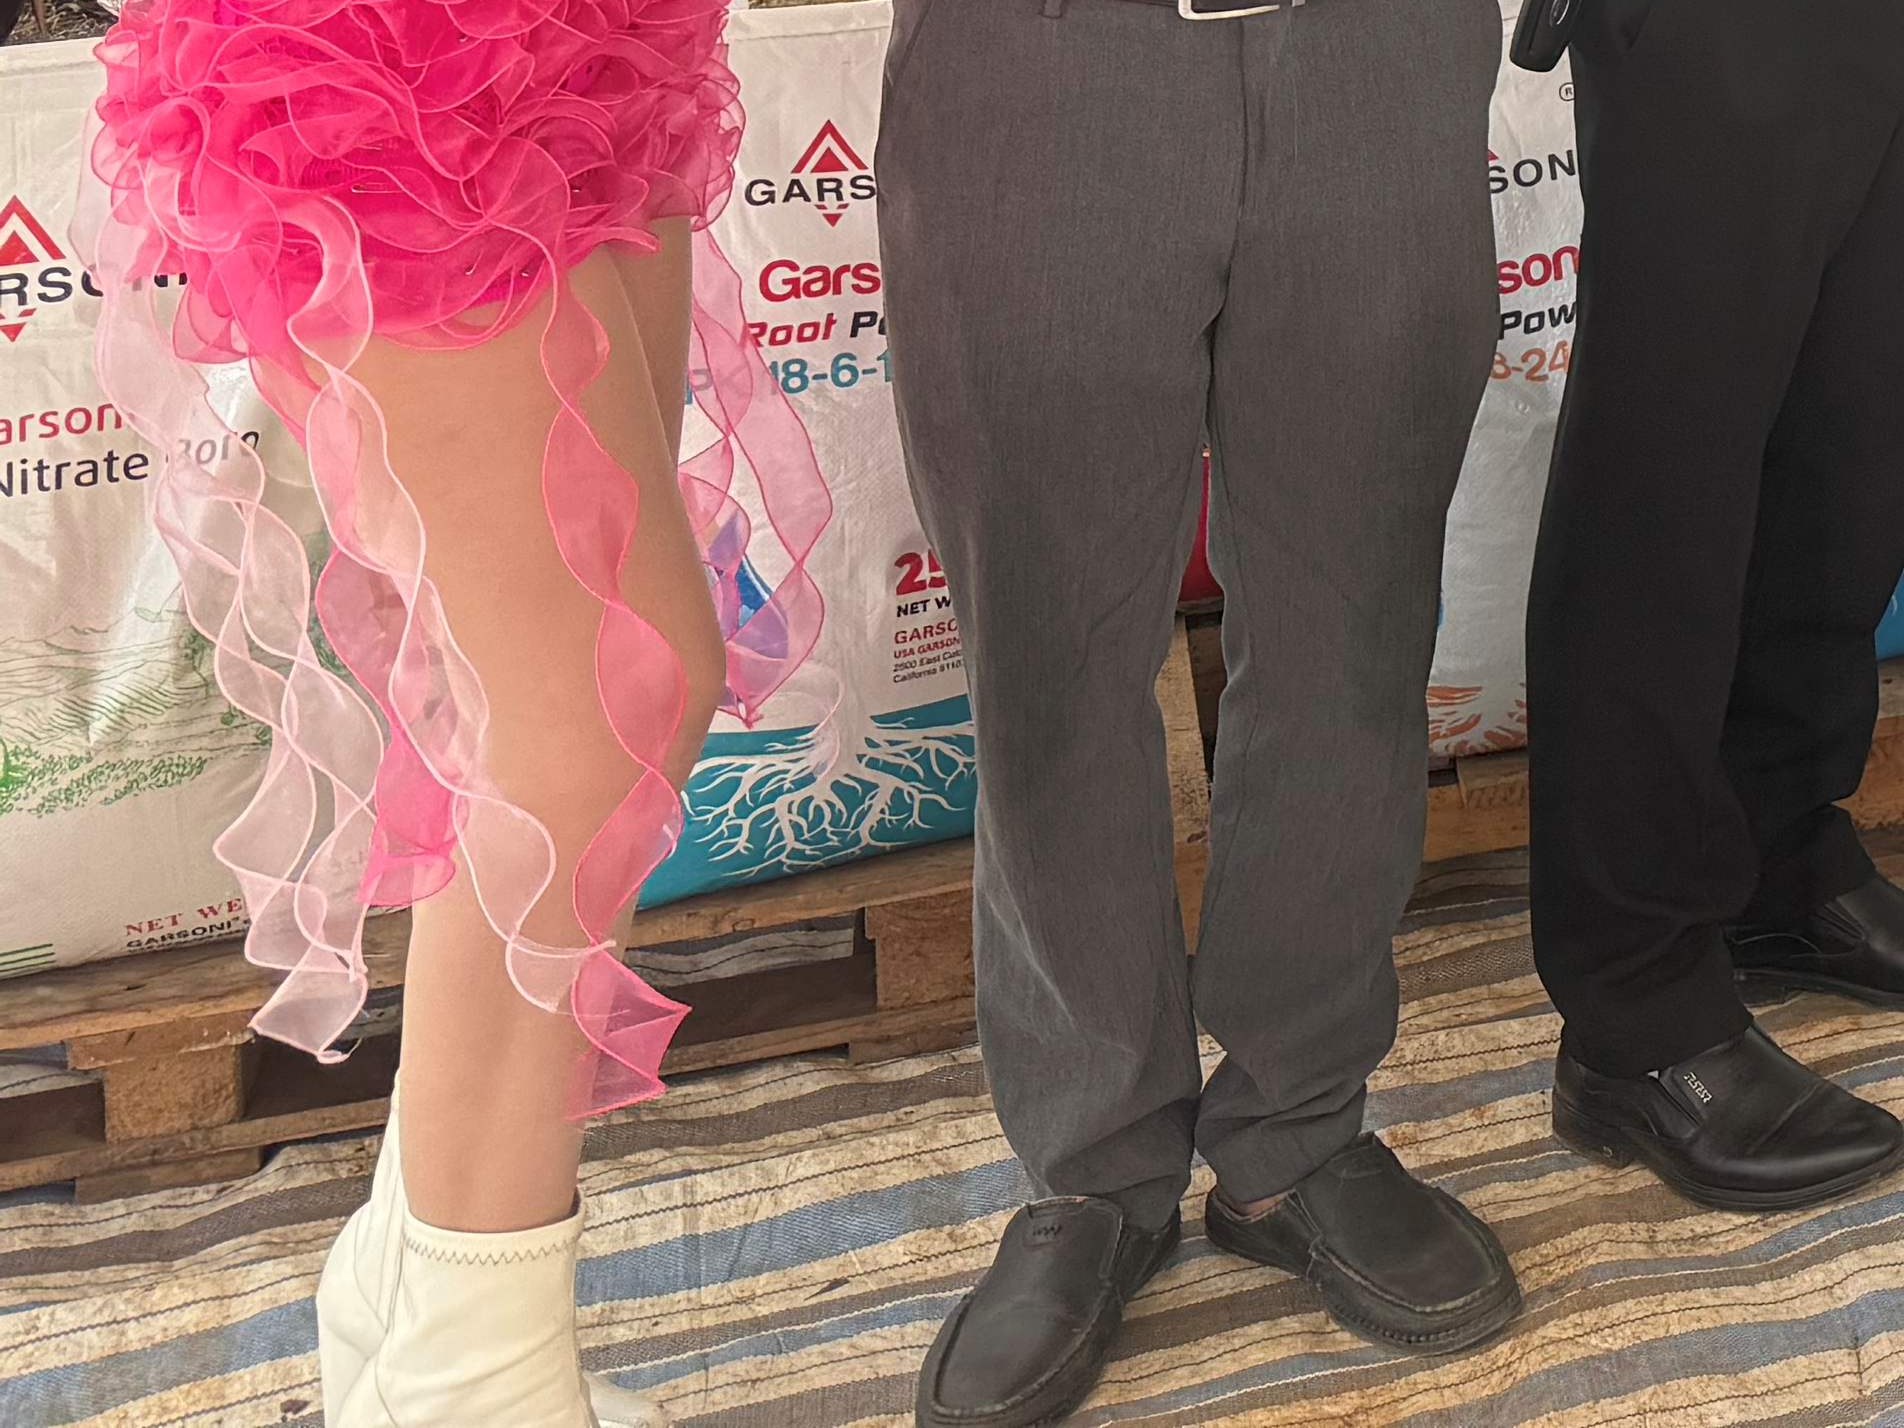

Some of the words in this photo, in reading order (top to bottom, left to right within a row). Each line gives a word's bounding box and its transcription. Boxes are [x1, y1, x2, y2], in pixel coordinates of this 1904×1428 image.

[744, 173, 878, 206] GARS
[759, 258, 882, 303] Gars
[896, 599, 930, 618] NET
